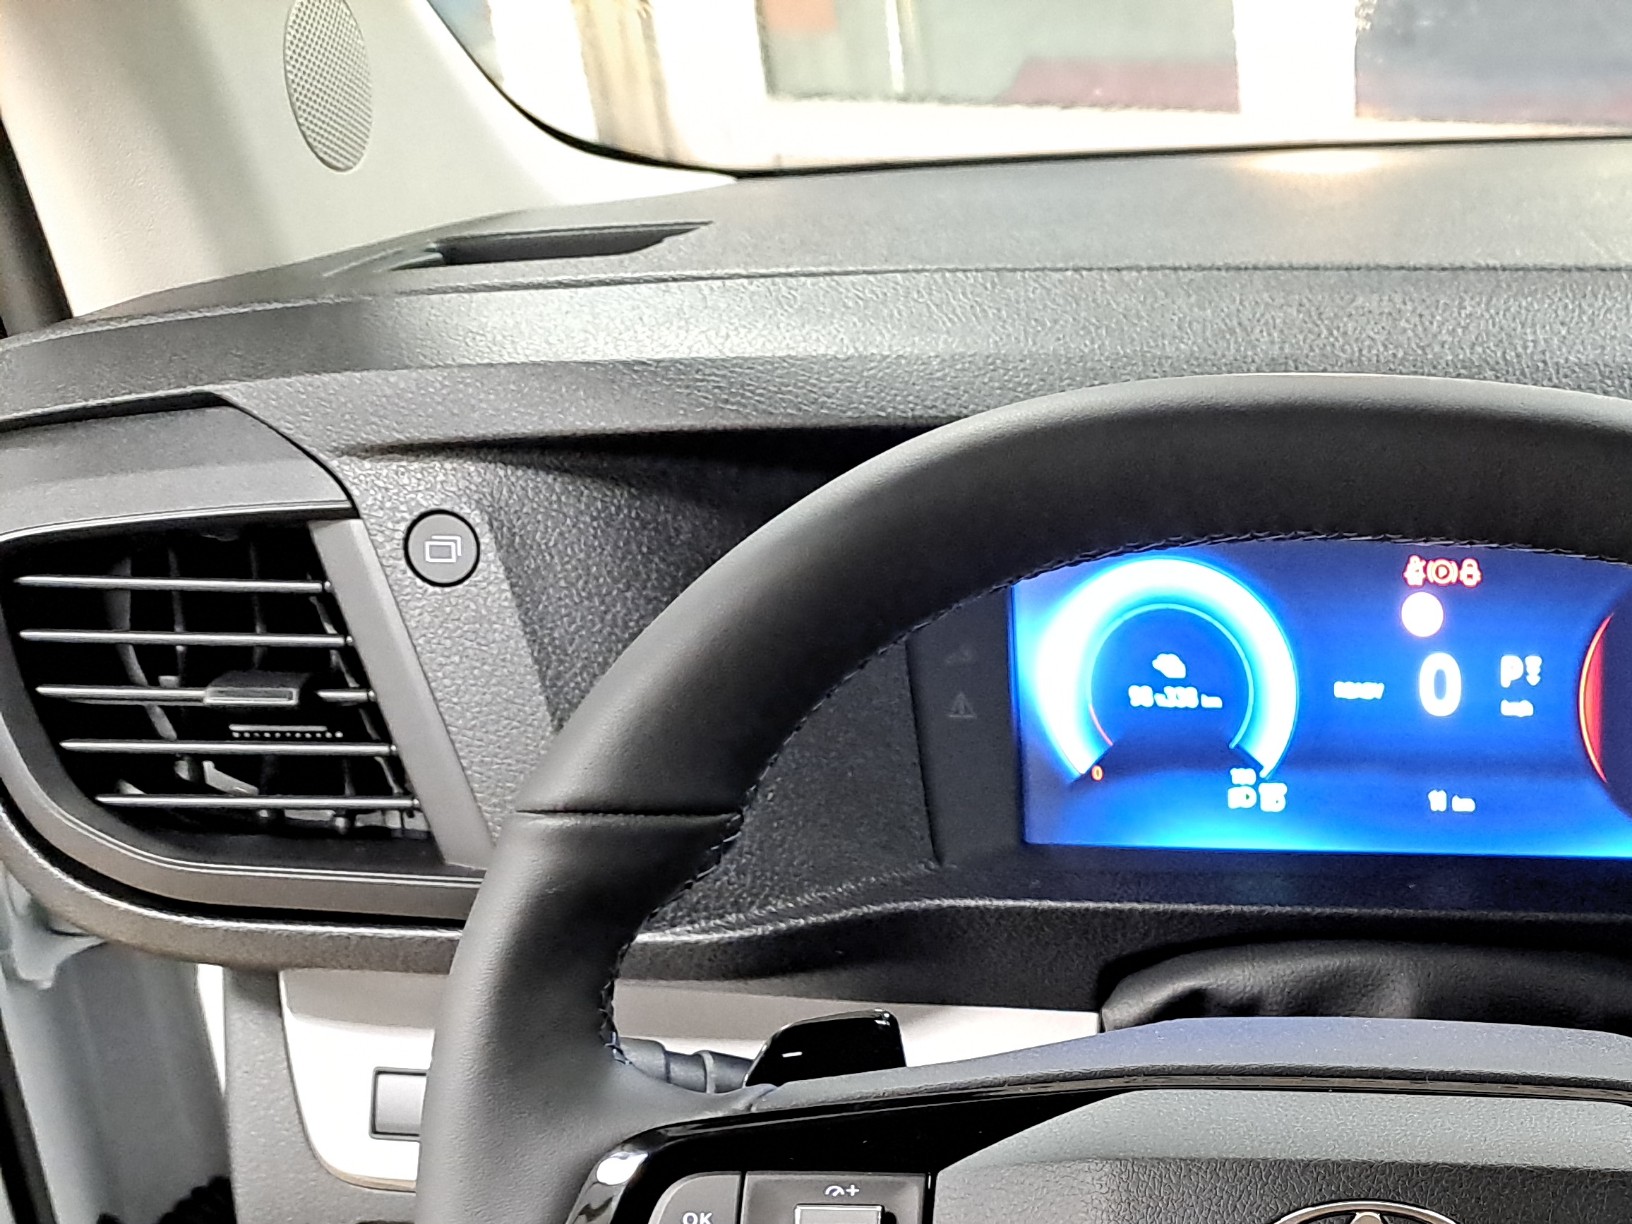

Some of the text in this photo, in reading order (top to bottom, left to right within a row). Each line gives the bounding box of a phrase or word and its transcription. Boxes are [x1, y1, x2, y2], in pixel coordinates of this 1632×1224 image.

[1419, 652, 1462, 717] 0
[1500, 655, 1524, 688] P
[1091, 765, 1103, 781] 0
